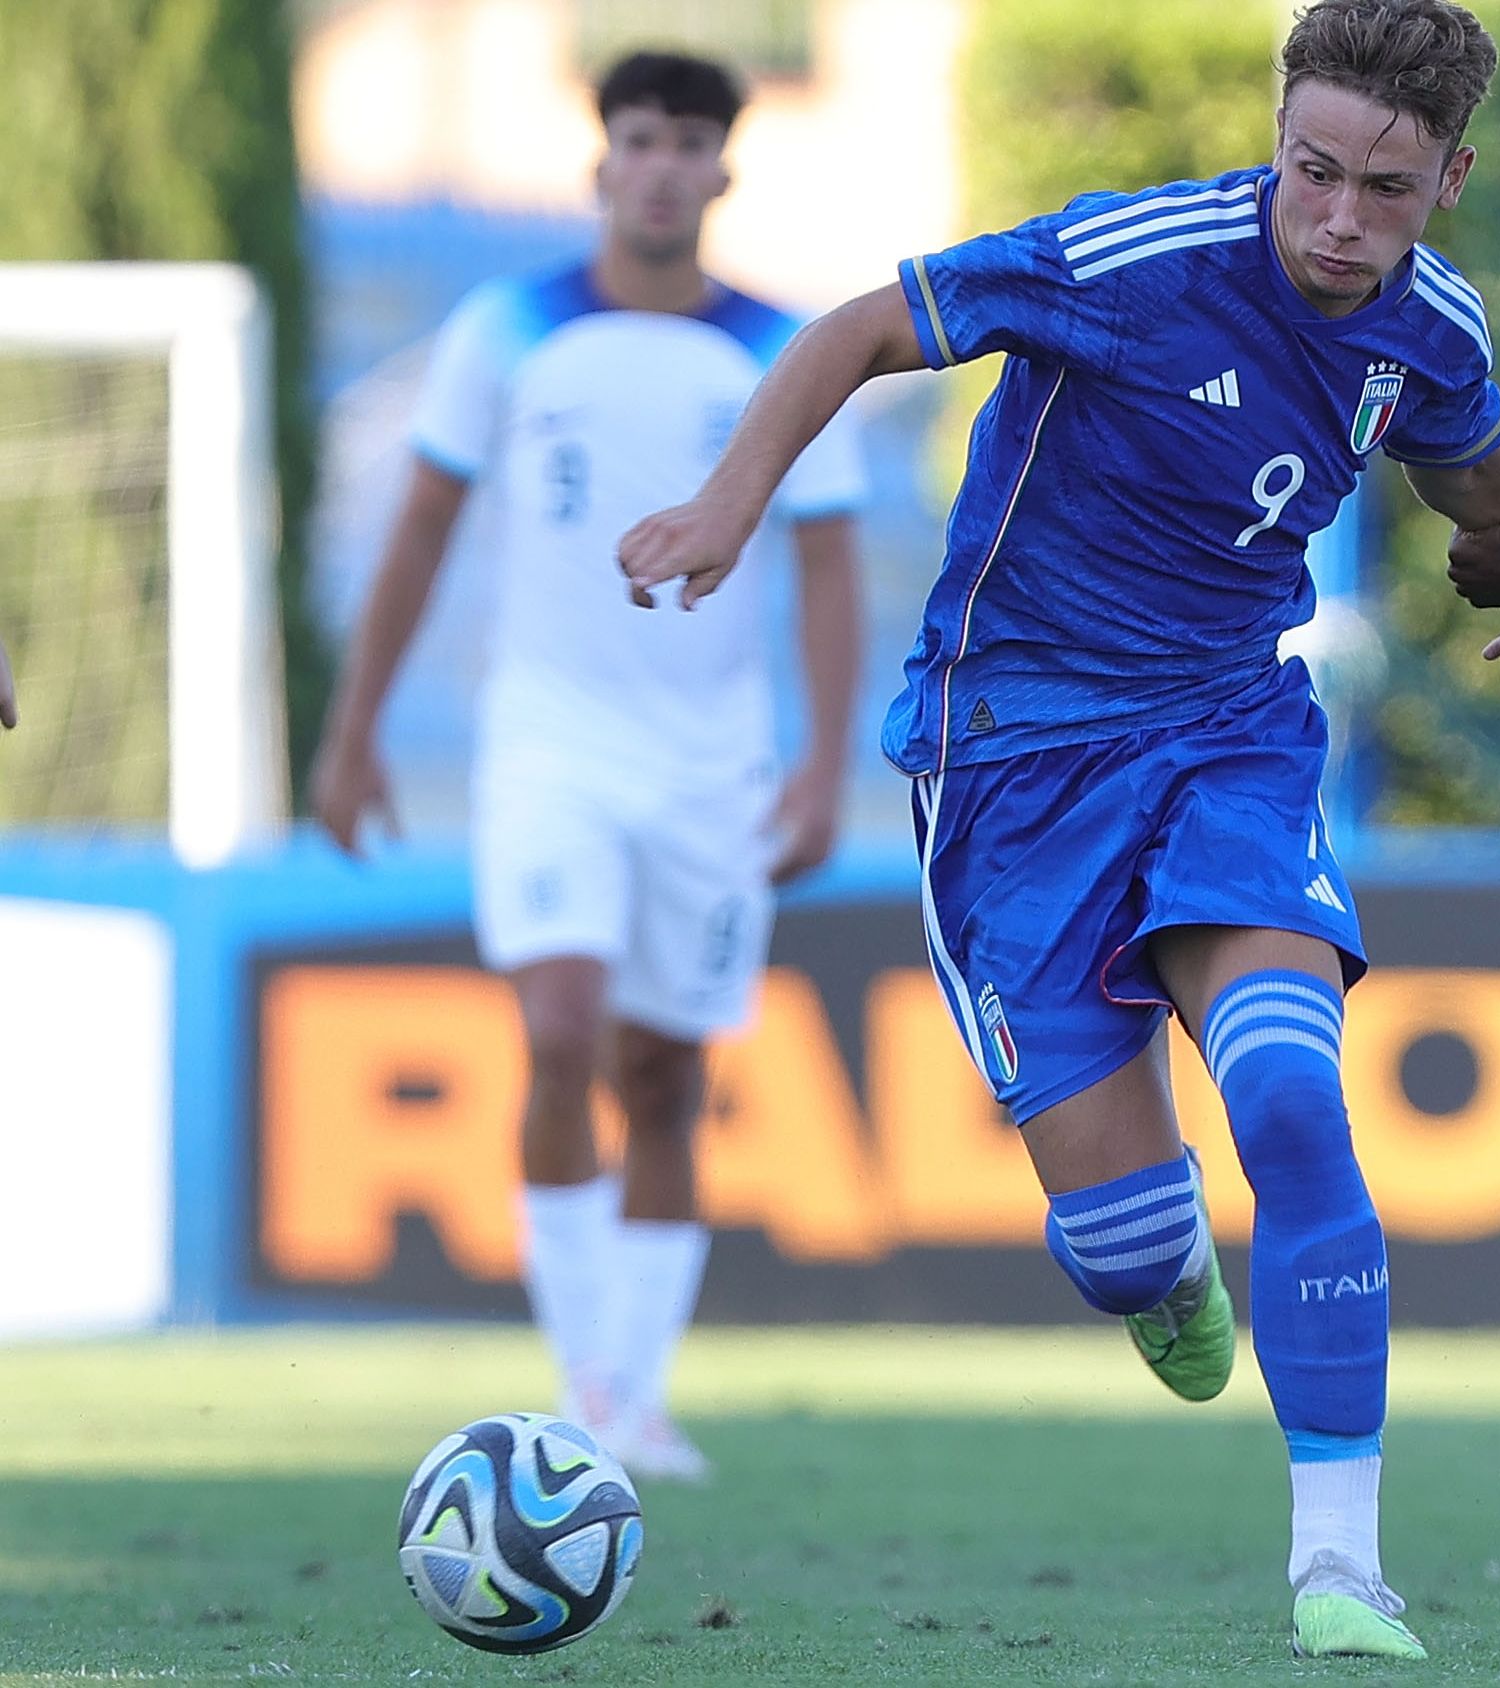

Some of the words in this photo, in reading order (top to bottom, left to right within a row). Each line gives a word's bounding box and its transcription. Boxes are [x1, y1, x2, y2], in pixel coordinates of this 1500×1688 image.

[1365, 381, 1399, 399] ITALIA
[1233, 453, 1305, 547] 9
[1299, 1265, 1389, 1303] ITALIA
